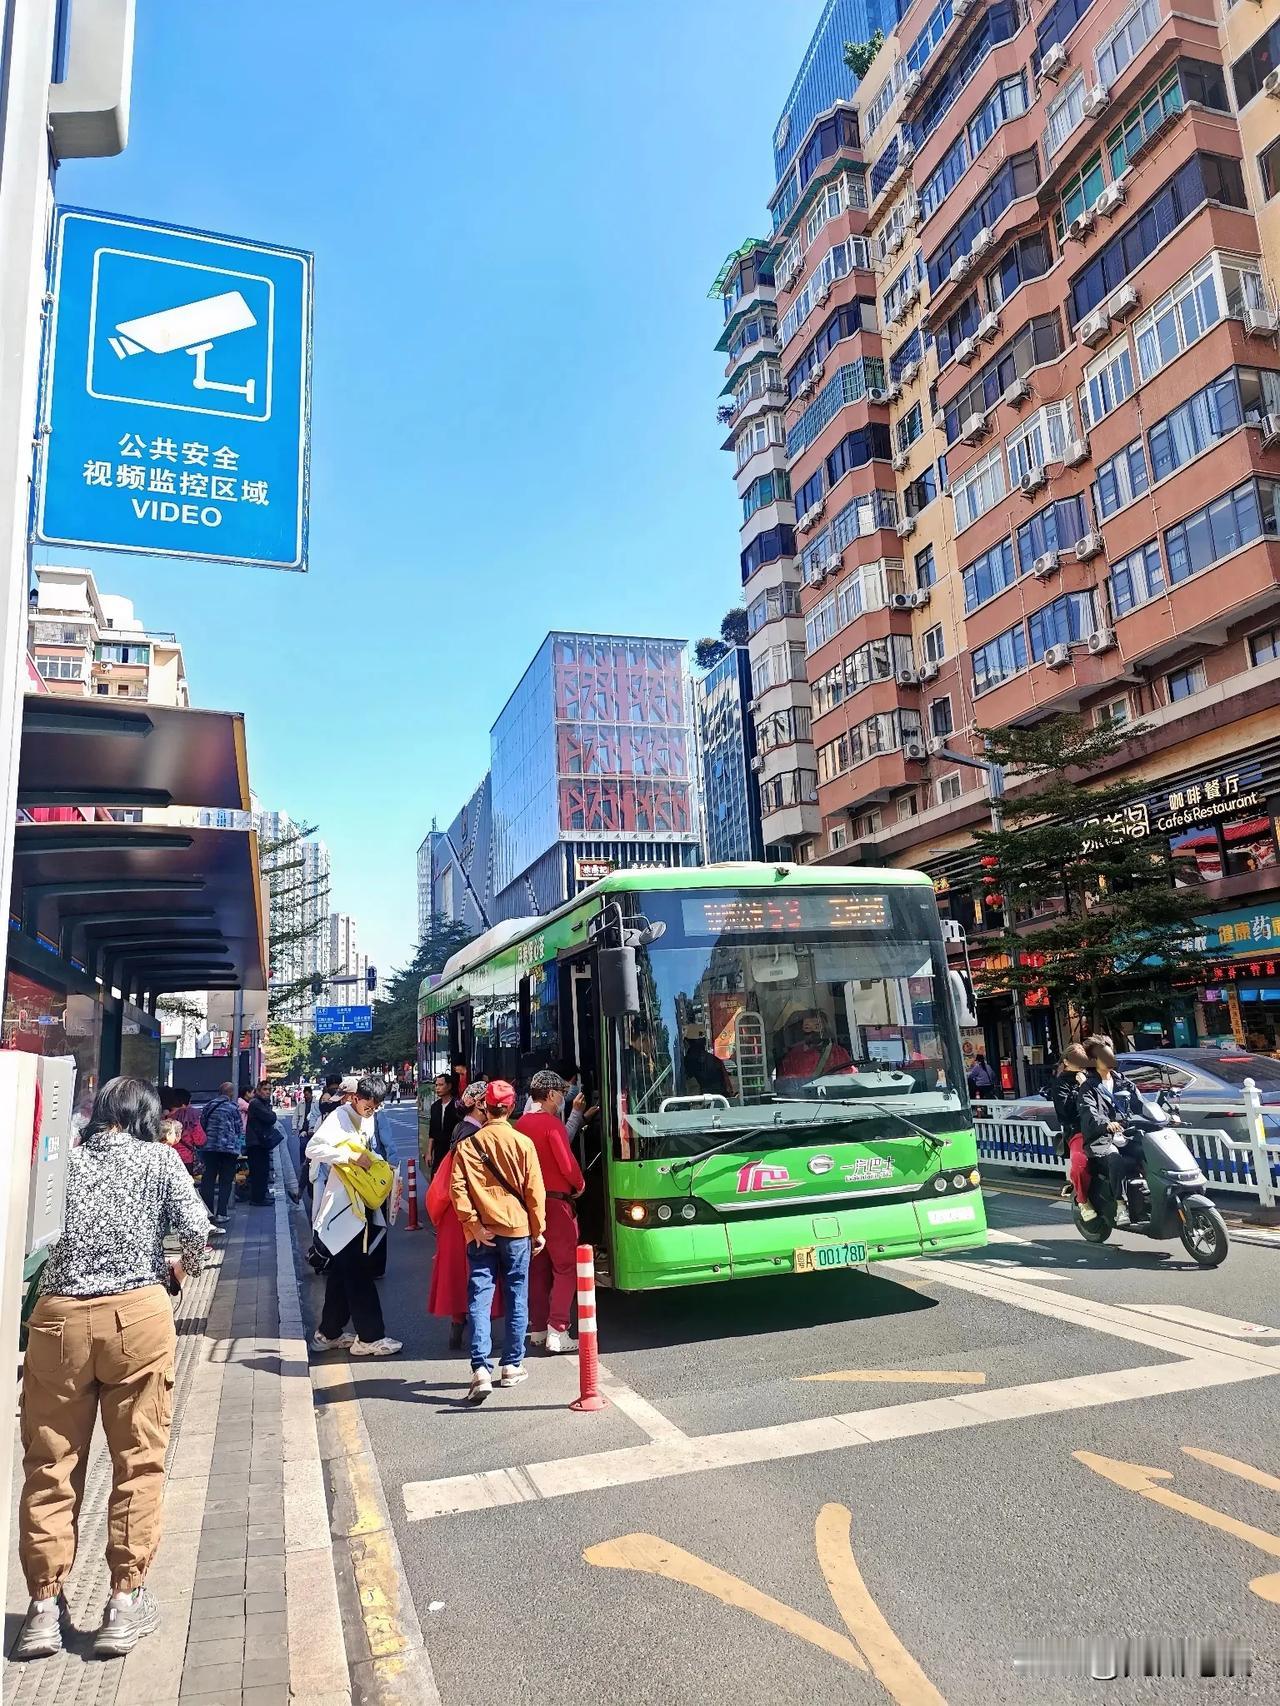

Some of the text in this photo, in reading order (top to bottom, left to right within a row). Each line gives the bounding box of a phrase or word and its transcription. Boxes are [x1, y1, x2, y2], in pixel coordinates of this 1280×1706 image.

[118, 432, 241, 471] 公共安全
[82, 459, 271, 506] 视频监控区域
[131, 499, 223, 529] VIDEO
[1168, 773, 1240, 811] 咖啡餐厅
[1157, 793, 1258, 831] Cafe&Restaurant
[840, 1155, 895, 1175] 一汽巴士
[818, 1244, 866, 1266] 00178D
